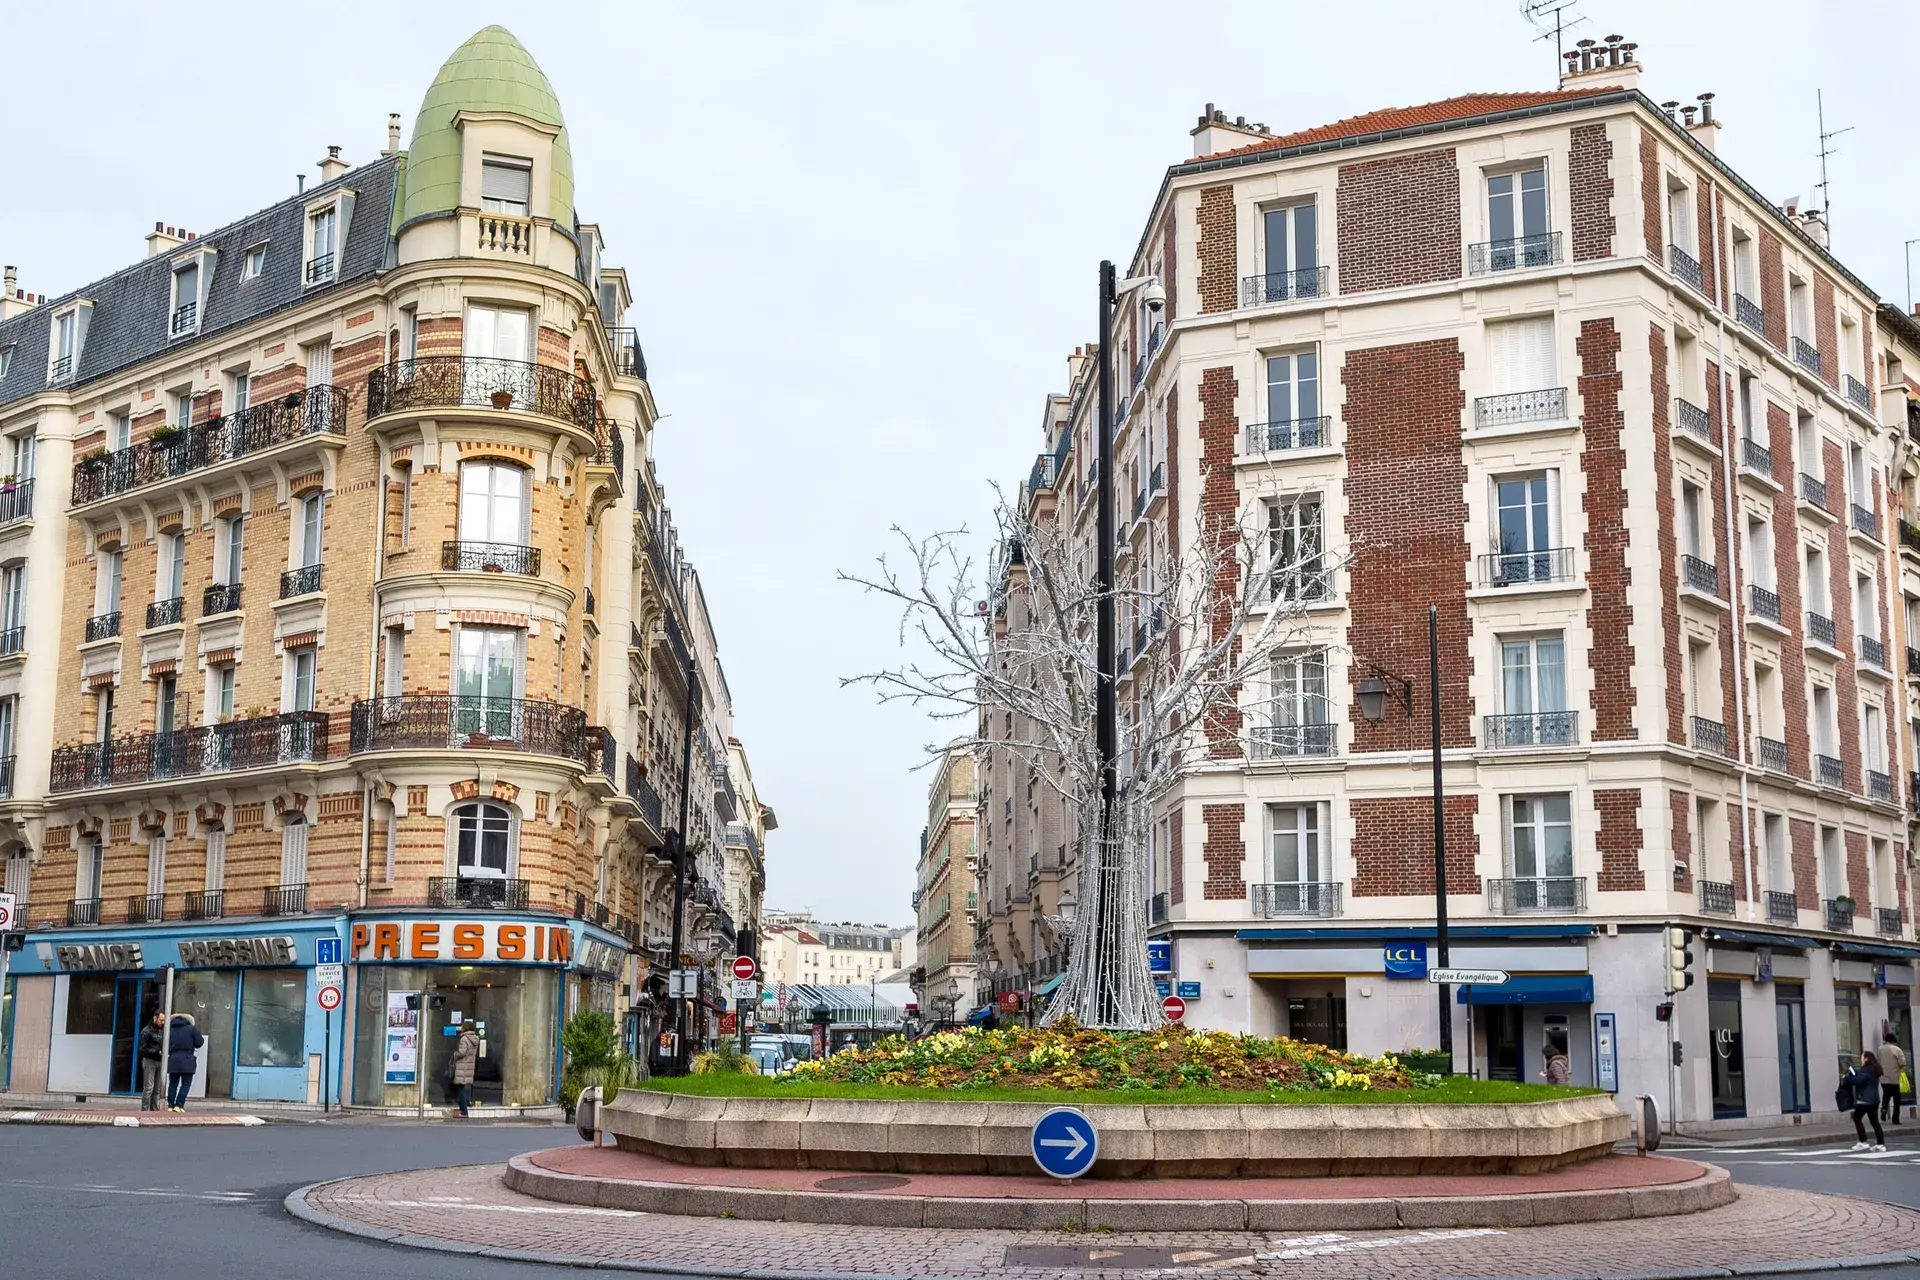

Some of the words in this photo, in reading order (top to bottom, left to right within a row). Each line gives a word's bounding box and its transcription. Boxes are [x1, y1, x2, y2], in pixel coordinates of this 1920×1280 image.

[352, 923, 575, 962] PRESSIN
[57, 942, 144, 970] FRANCE
[178, 936, 297, 967] PRESSING
[1148, 949, 1167, 959] CL
[1386, 949, 1422, 961] LCL
[1433, 970, 1454, 981] Église
[1456, 971, 1499, 983] Évangélique
[1717, 1028, 1734, 1043] LCL
